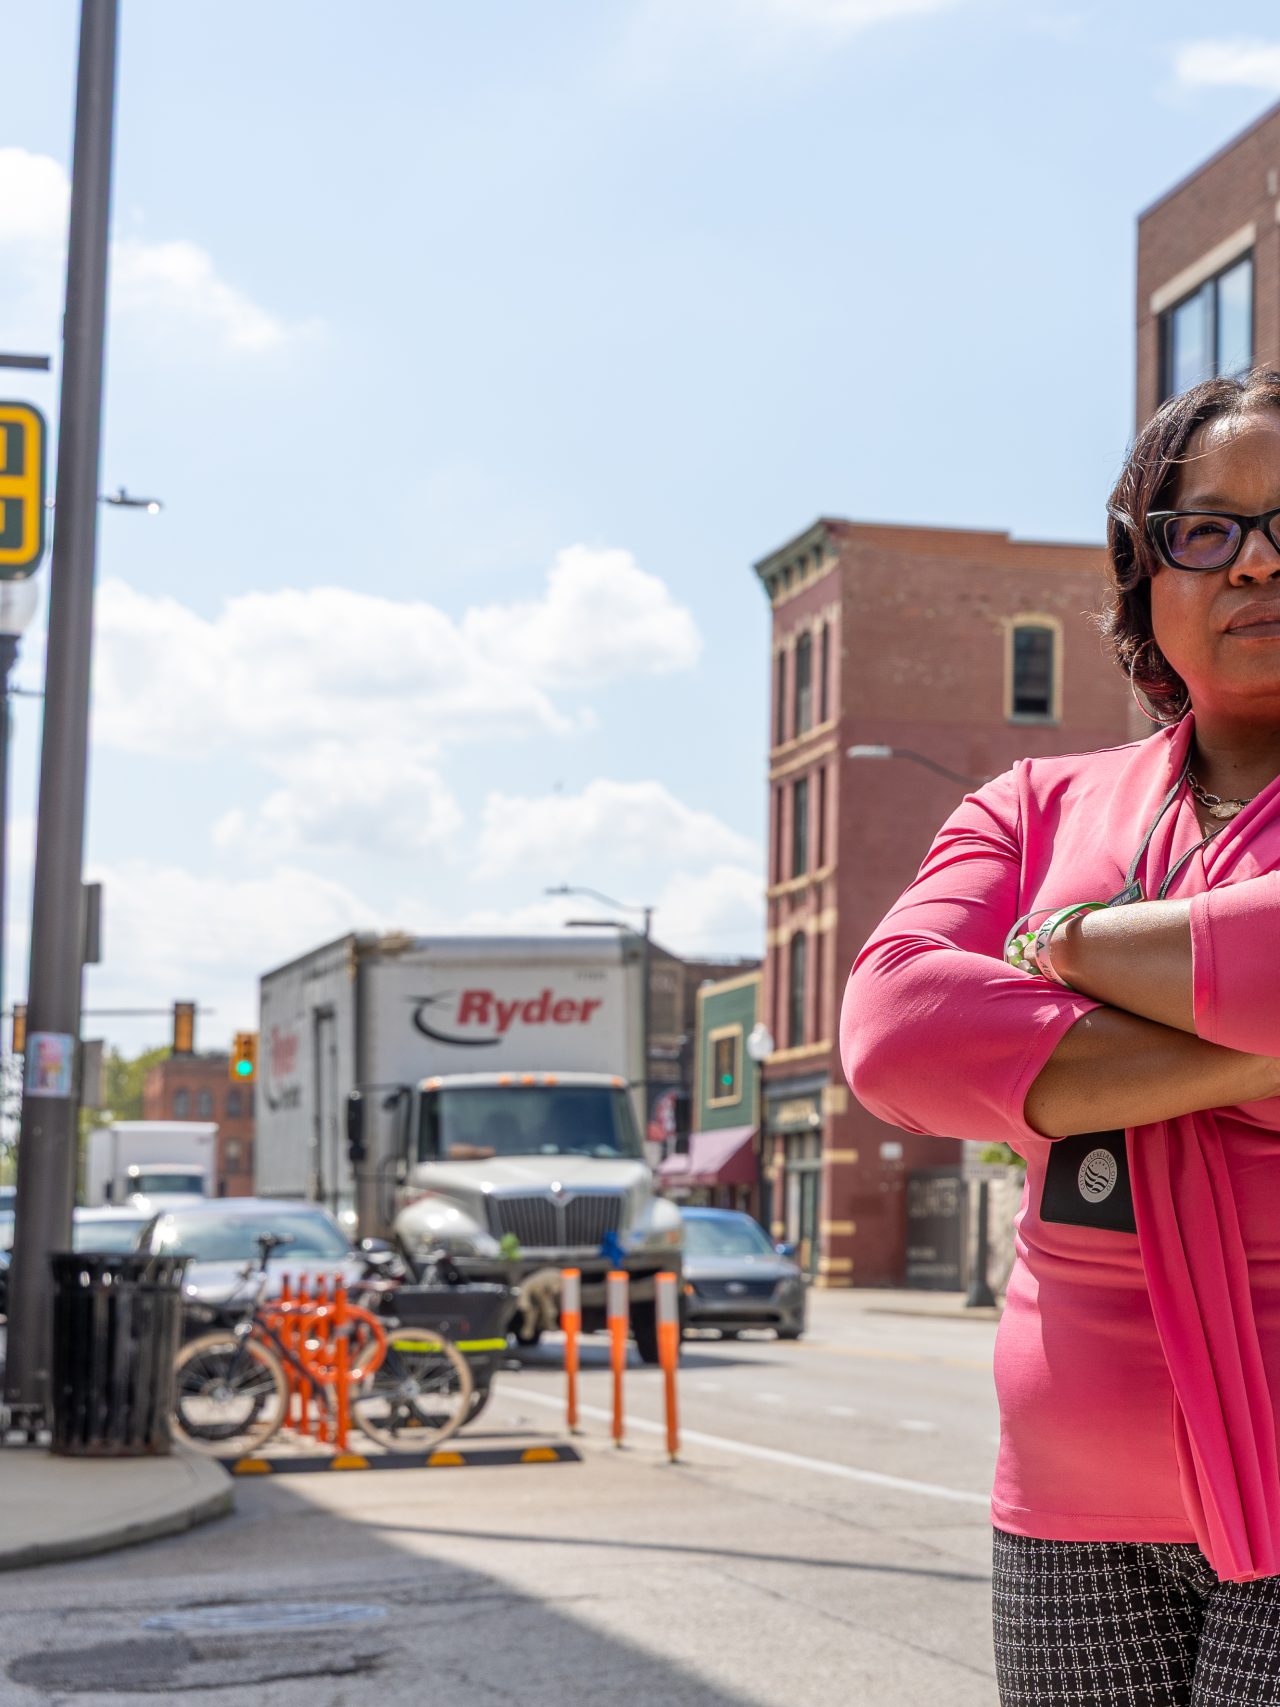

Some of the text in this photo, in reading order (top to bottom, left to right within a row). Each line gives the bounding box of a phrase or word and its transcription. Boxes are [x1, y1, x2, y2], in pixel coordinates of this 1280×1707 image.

[457, 987, 603, 1034] Ryder
[1086, 1151, 1115, 1168] CLEVELAND
[1106, 1171, 1116, 1191] OHIO
